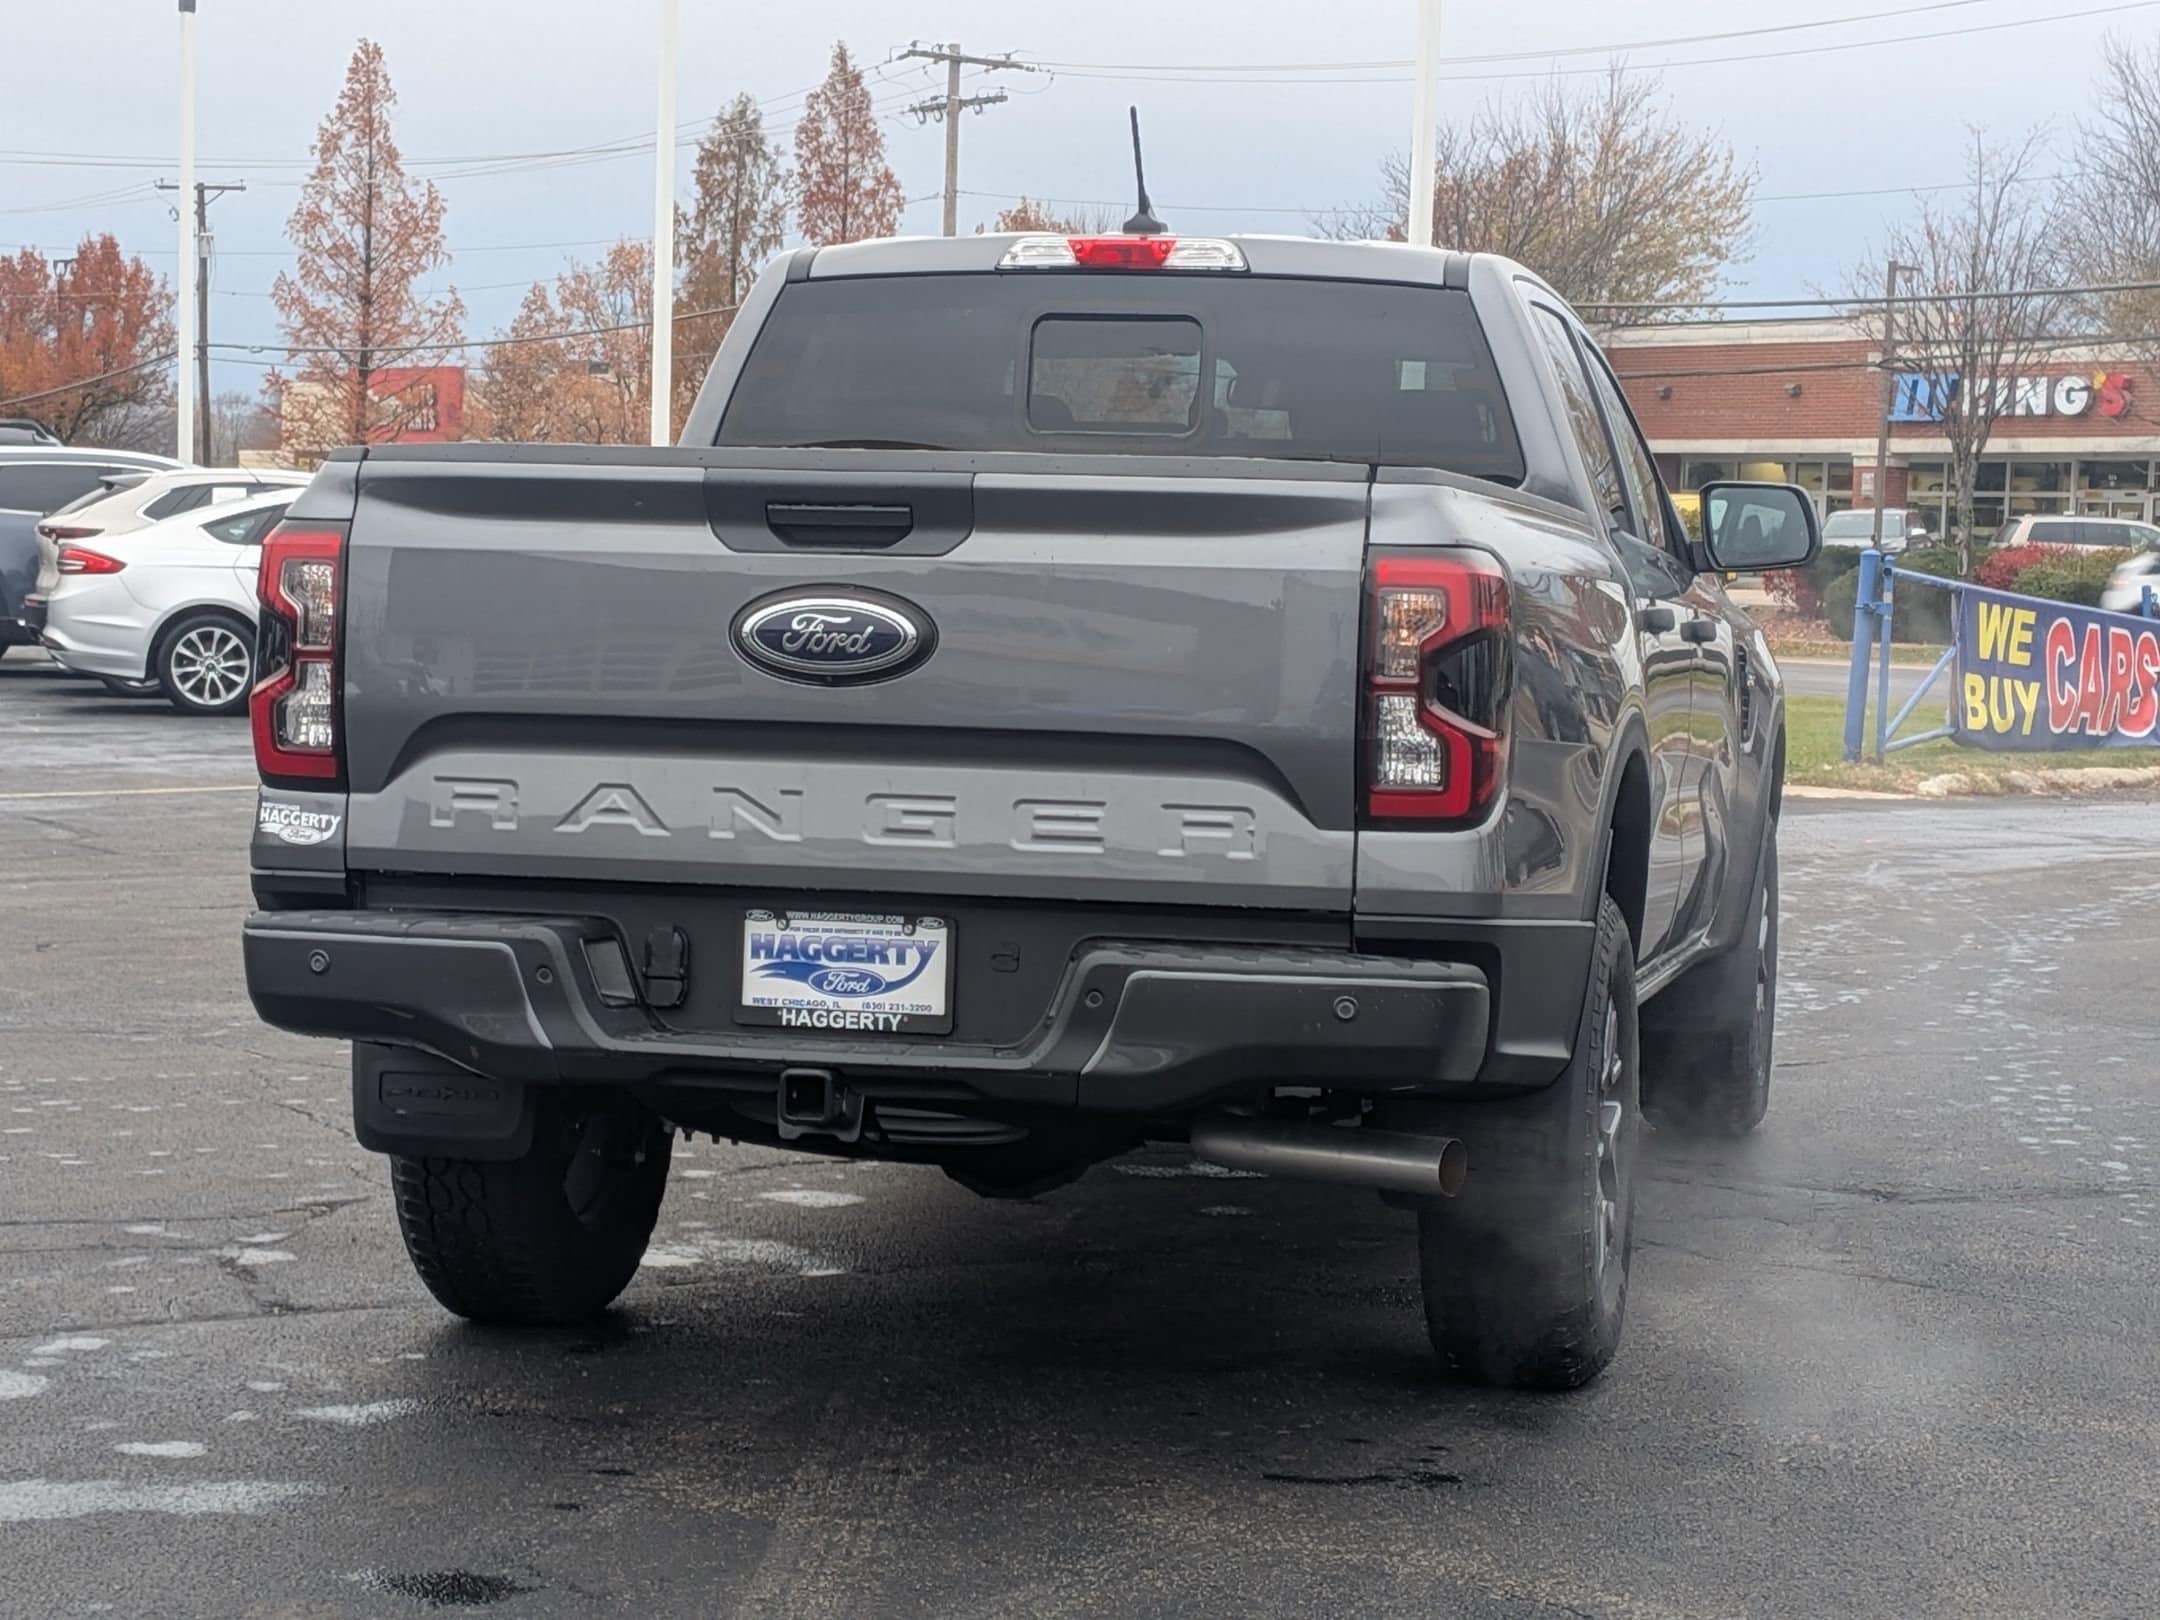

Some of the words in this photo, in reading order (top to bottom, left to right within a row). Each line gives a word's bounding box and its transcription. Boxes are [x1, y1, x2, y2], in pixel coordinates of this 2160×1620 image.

[782, 613, 875, 655] Ford
[1979, 601, 2037, 666] WE
[2046, 617, 2160, 738] CARS
[1964, 672, 2041, 736] BUY
[260, 806, 341, 831] HAGGERTY
[429, 774, 1256, 861] RANGER
[750, 933, 940, 966] HAGGERTY
[823, 972, 870, 993] Ford
[780, 1008, 902, 1032] HAGGERTY
